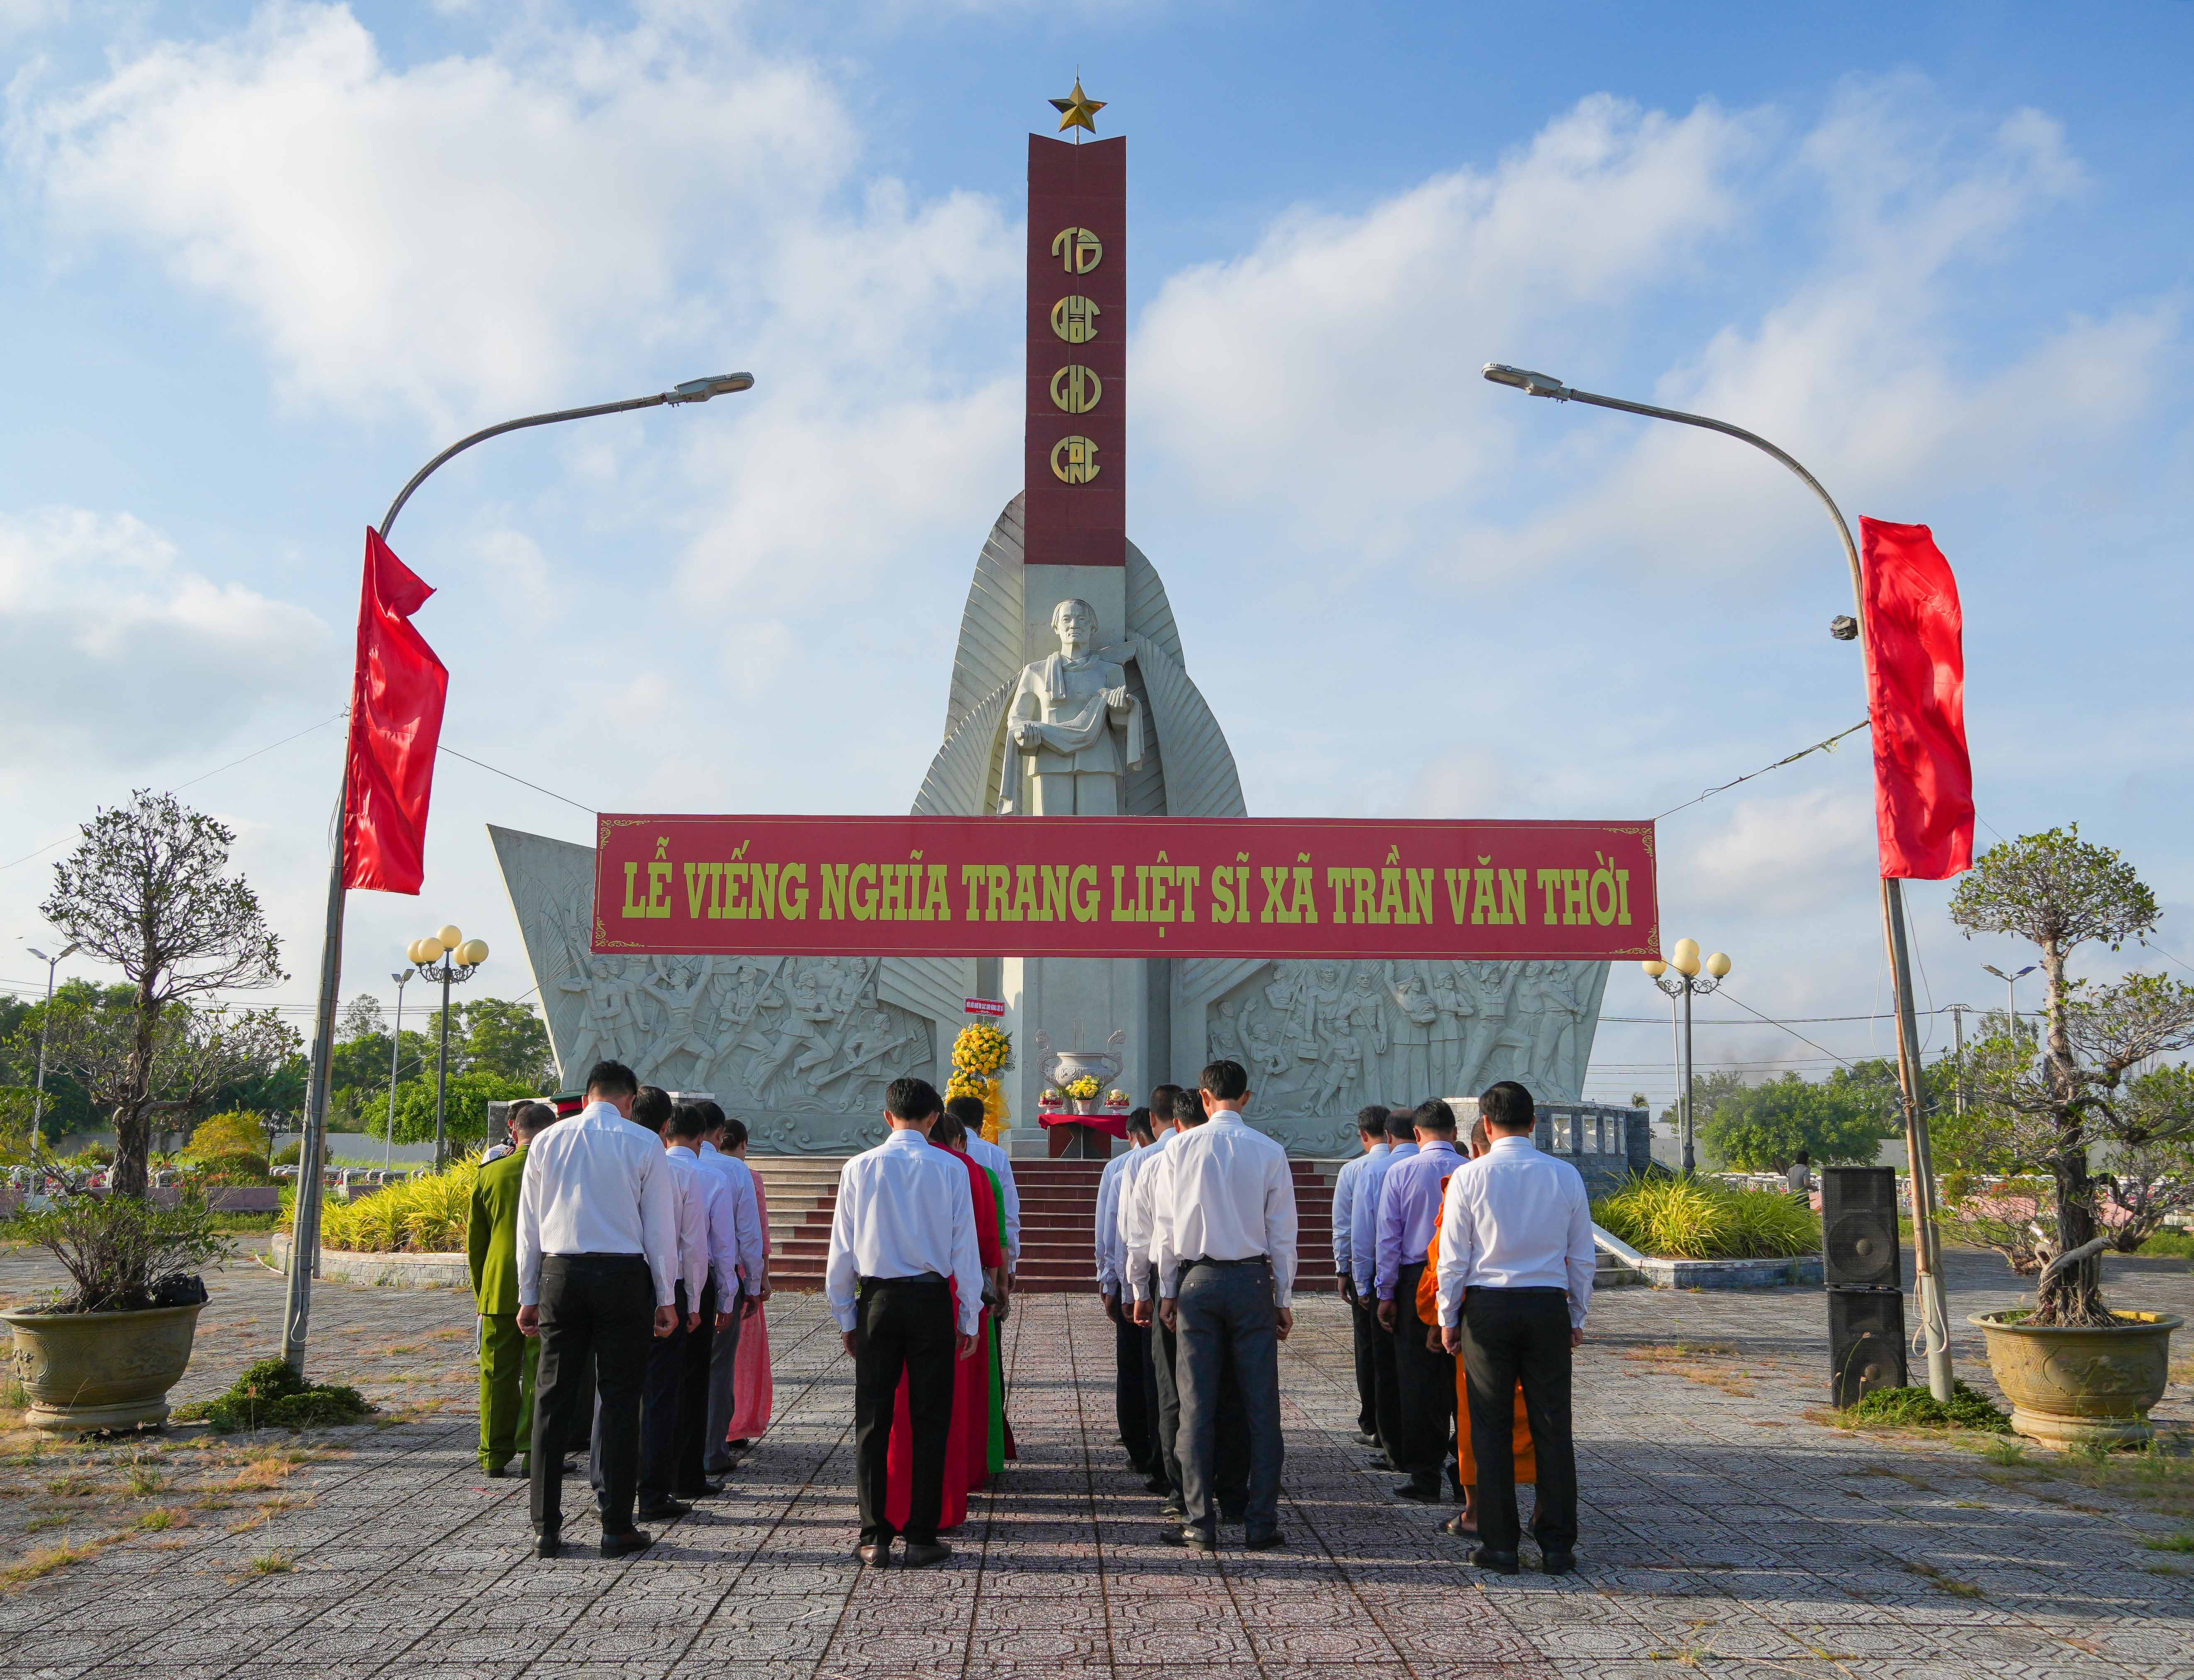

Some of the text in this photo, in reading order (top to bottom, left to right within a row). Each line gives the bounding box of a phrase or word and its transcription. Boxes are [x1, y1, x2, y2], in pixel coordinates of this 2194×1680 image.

[622, 837, 1632, 938] LỄ VIẾNG NGHĨA TRANG LIỆT SĨ XÃ TRẦN VĂN THỜI
